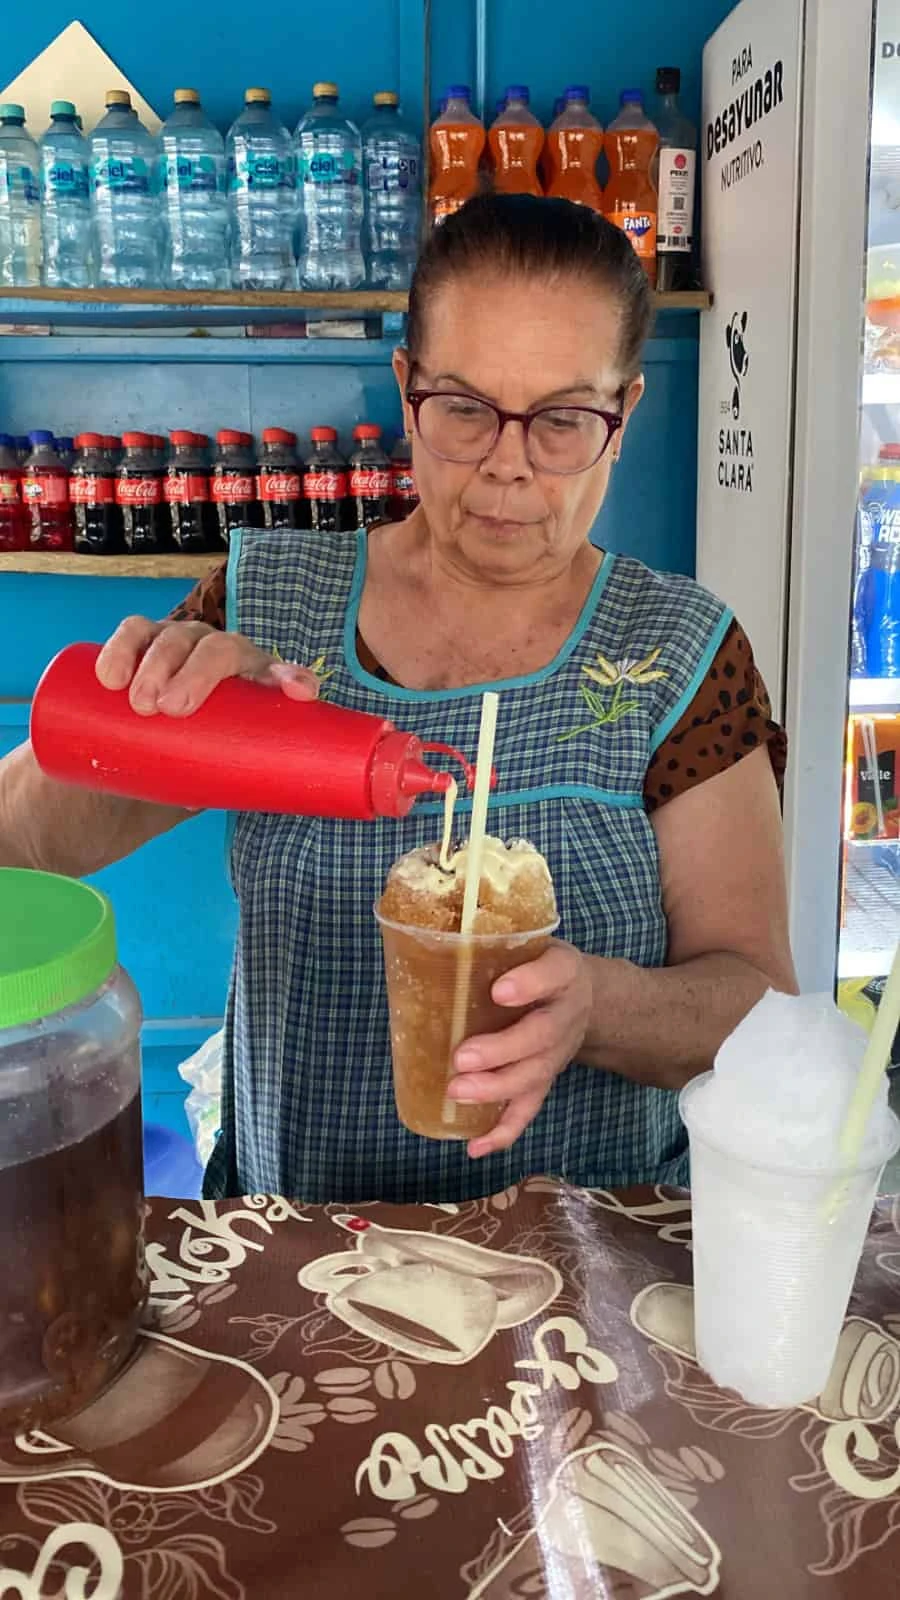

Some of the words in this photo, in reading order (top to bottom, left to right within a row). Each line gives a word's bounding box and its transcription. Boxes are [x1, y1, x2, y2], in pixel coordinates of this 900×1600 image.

[732, 43, 753, 86] PARA
[310, 157, 335, 172] ciel
[721, 140, 764, 192] NUTRITIVO.
[719, 428, 753, 456] SANTA
[717, 460, 753, 492] CLARA
[355, 1316, 619, 1501] Expresso
